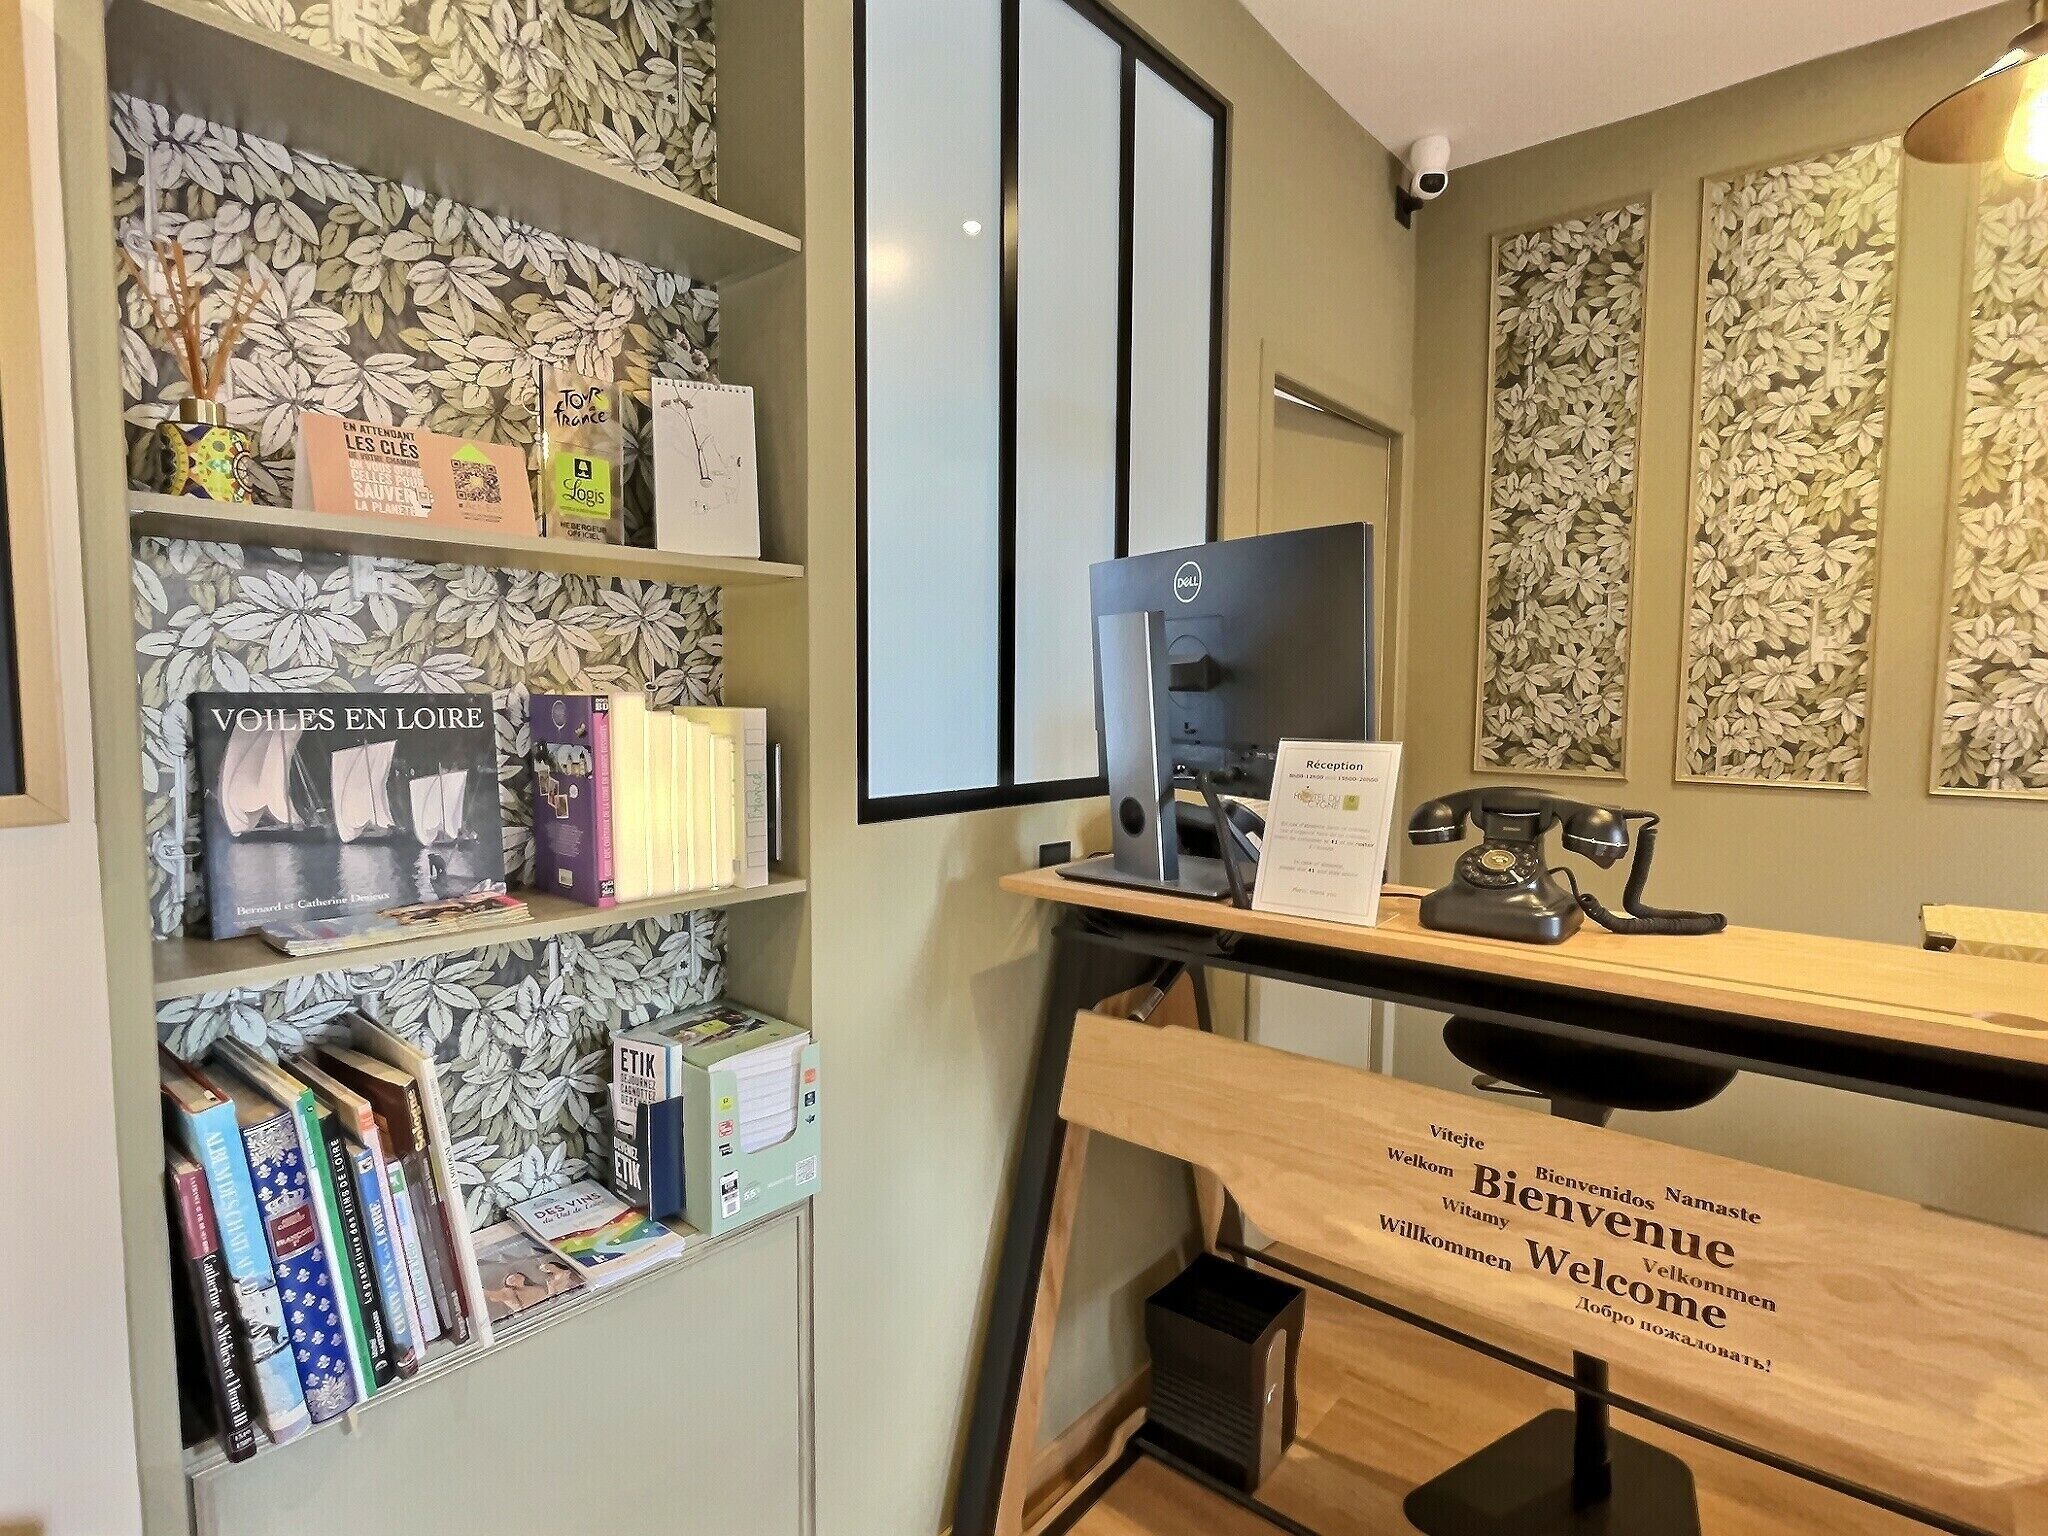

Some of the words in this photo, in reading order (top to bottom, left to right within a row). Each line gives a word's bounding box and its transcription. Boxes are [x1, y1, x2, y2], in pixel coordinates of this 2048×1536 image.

[343, 421, 356, 431] EN
[360, 425, 416, 441] ATTENDANT
[345, 434, 375, 453] LES
[562, 478, 605, 507] Logis
[1177, 575, 1199, 588] DELL
[211, 708, 335, 734] VOILES
[345, 708, 388, 731] EN
[396, 706, 485, 731] LOIRE
[1306, 760, 1364, 771] Réception
[236, 902, 282, 916] Bernard
[297, 896, 348, 909] Catherine
[620, 1048, 655, 1078] ETIK
[409, 1088, 426, 1152] Sologne
[1430, 1124, 1484, 1150] Vítejte
[330, 1138, 345, 1173] LOIRE
[614, 1150, 642, 1191] ETIK
[1387, 1147, 1454, 1177] Welkom
[337, 1173, 349, 1189] DE
[1535, 1166, 1656, 1211] Bienvenidos
[341, 1189, 354, 1216] VINS
[534, 1204, 565, 1219] DES
[566, 1192, 601, 1208] VINS
[1442, 1197, 1510, 1230] Witamy
[1470, 1163, 1735, 1268] Bienvenue
[1665, 1186, 1762, 1225] Namaste
[348, 1217, 359, 1234] des
[353, 1236, 363, 1260] livre
[1379, 1214, 1512, 1271] Willkommen
[203, 1254, 220, 1308] Catherine
[357, 1261, 372, 1293] grand
[1525, 1237, 1728, 1329] Welcome
[1642, 1258, 1777, 1312] Velkommen
[213, 1310, 227, 1324] de
[217, 1324, 235, 1368] Médicis
[1575, 1296, 1634, 1326] Добро
[1640, 1320, 1772, 1373] пожаловать!
[226, 1378, 245, 1413] Henri
